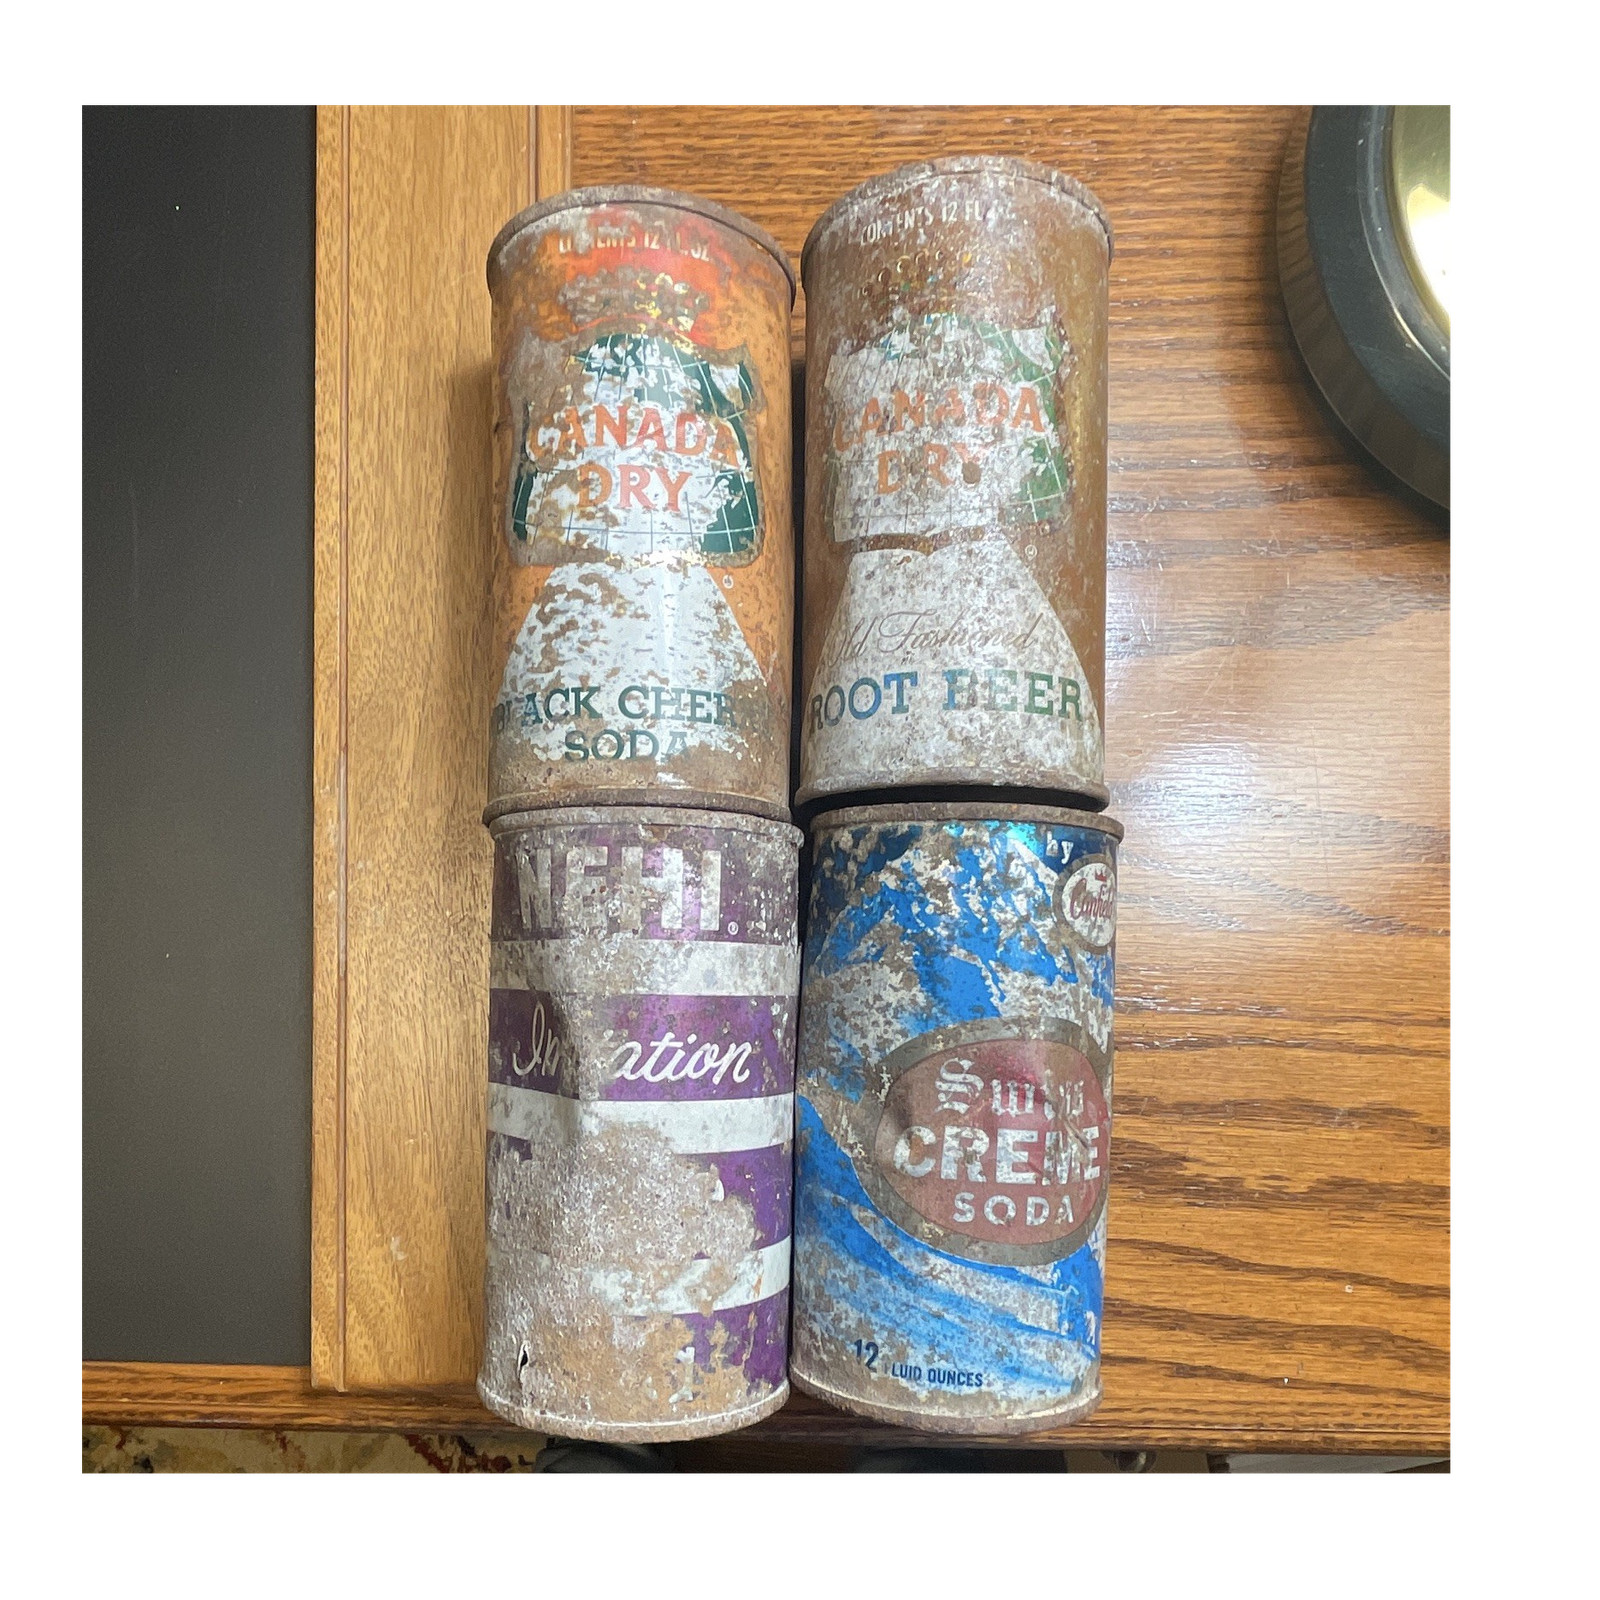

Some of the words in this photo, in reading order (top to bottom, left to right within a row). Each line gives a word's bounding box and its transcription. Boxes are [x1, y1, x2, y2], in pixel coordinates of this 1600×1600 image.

[941, 200, 959, 223] 12
[527, 403, 740, 470] CANADA
[577, 462, 692, 512] DRY
[809, 670, 918, 735] ROOT
[942, 668, 1082, 723] BEER
[564, 729, 688, 765] SODA
[1045, 830, 1075, 866] by
[515, 846, 722, 931] NEHI
[892, 1125, 1101, 1187] CREME
[952, 1191, 1075, 1226] SODA
[853, 1338, 880, 1374] 12
[927, 1367, 984, 1388] OUNCES
